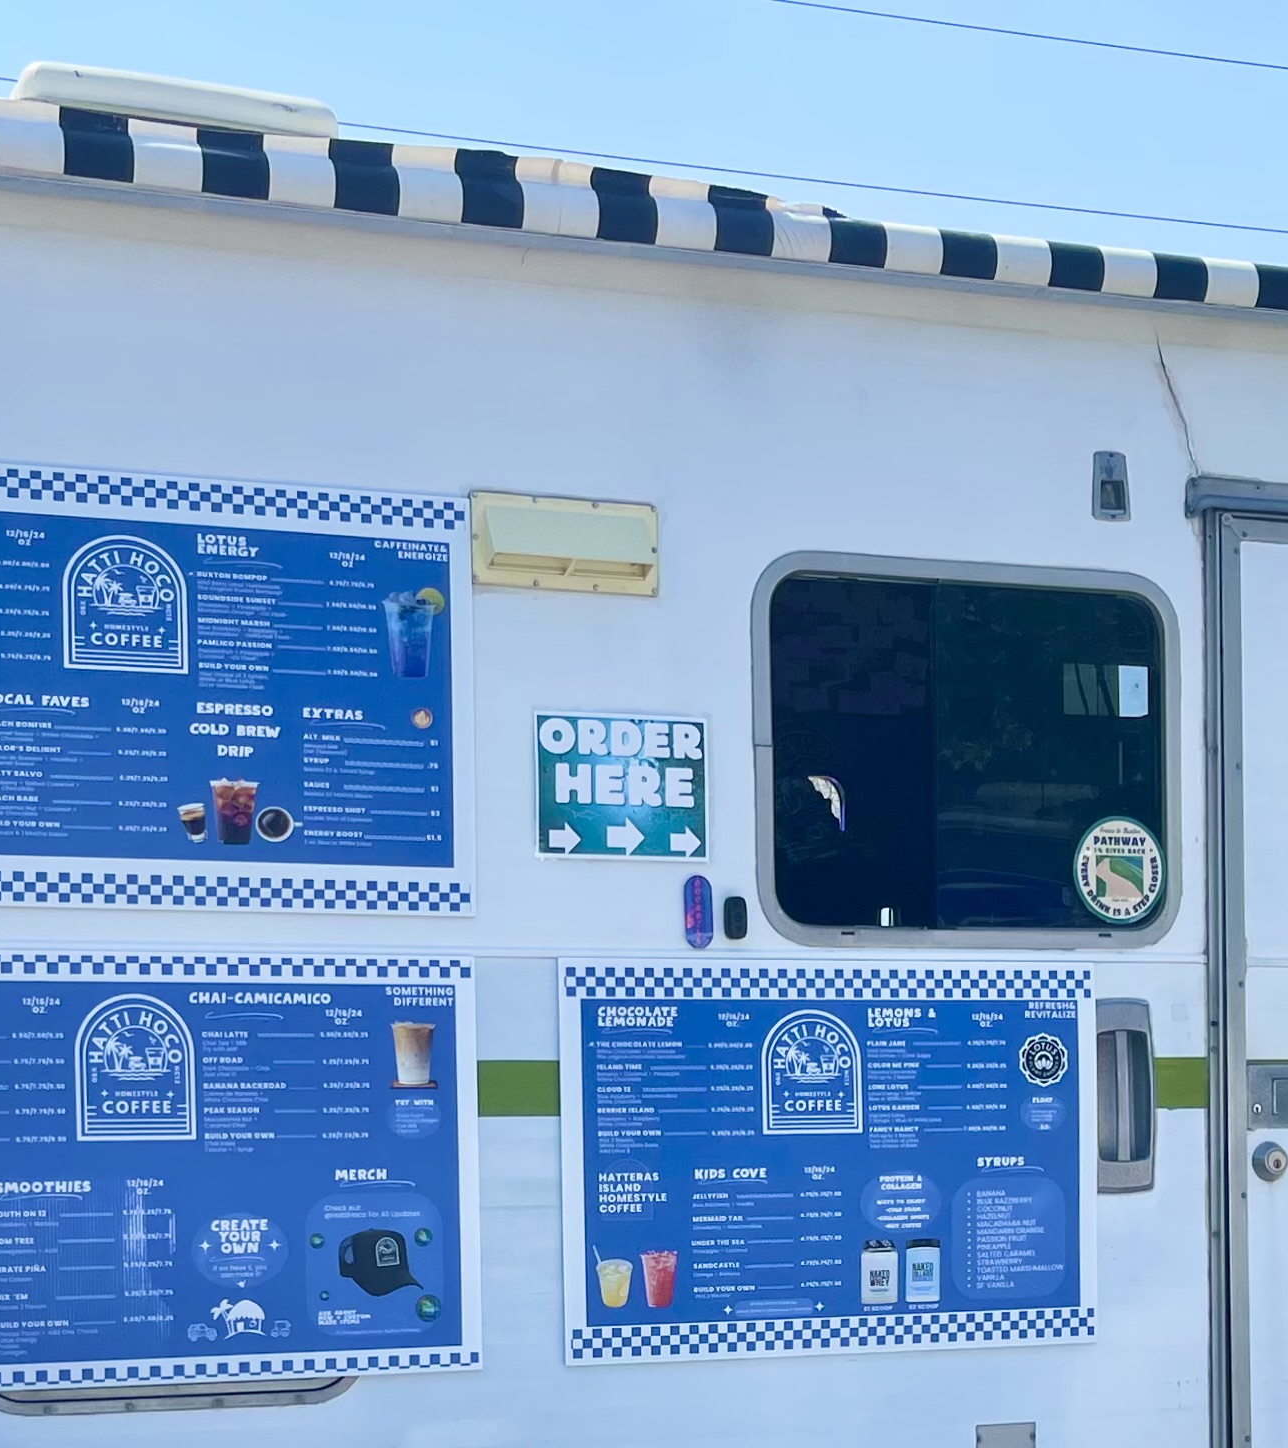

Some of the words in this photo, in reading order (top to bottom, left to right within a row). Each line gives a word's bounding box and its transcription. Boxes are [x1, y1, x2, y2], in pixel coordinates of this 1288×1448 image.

[197, 534, 247, 546] LOTUS
[197, 543, 259, 557] ENERGY
[398, 552, 448, 562] ENERGIZE
[77, 551, 121, 597] HATTI
[130, 552, 175, 602] HOCO
[197, 594, 243, 602] SOUNDSIDE
[245, 596, 276, 604] SUNSET
[197, 617, 239, 625] MIDNIGHT
[104, 624, 149, 632] HOMESTYLE
[91, 632, 163, 648] COFFEE
[249, 664, 269, 672] OWN
[41, 694, 89, 708] FAVES
[197, 702, 273, 717] ESPRESSO
[303, 708, 363, 720] EXTRAS
[15, 721, 52, 729] BONFIRE
[190, 722, 229, 736] COLD
[236, 724, 281, 739] BREW
[539, 718, 702, 760] ORDER
[26, 746, 61, 754] DELIGHT
[217, 744, 254, 758] DRIP
[14, 770, 43, 778] SALVO
[555, 763, 694, 808] HERE
[12, 820, 37, 828] YOUR
[1094, 836, 1146, 846] PATHWAY
[1081, 855, 1090, 887] EVERY
[1087, 890, 1111, 913] DRINK
[1125, 908, 1130, 916] A
[1133, 895, 1150, 913] STEP
[1149, 856, 1159, 894] CLOSER
[386, 987, 453, 996] SOMETHING
[189, 992, 331, 1005] CHAI-CAMICAMICO
[394, 997, 453, 1007] DIFFERENT
[597, 1006, 678, 1017] CHOCOLATE
[868, 1008, 921, 1018] LEMONS
[928, 1008, 936, 1018] &
[597, 1017, 673, 1027] LEMONADE
[868, 1018, 910, 1028] LOTUS
[89, 1011, 130, 1063] HATTI
[139, 1011, 182, 1063] HOCO
[773, 1024, 807, 1069] HATTI
[815, 1025, 851, 1069] HOCO
[1029, 1043, 1057, 1055] LOTUS
[102, 1100, 171, 1114] COFFEE
[785, 1100, 841, 1112] COFFEE
[977, 1157, 1024, 1167] SYRUPS
[335, 1168, 387, 1181] MERCH
[599, 1172, 659, 1182] HATTERAS
[695, 1169, 725, 1180] KIDS
[732, 1168, 767, 1179] COVE
[599, 1183, 641, 1192] ISLAND
[599, 1193, 667, 1202] HOMESTYLE
[599, 1204, 642, 1213] COFFEE
[211, 1219, 268, 1231] CREATE
[219, 1231, 260, 1242] YOUR
[221, 1242, 258, 1254] OWN
[26, 1264, 46, 1272] PIÑA
